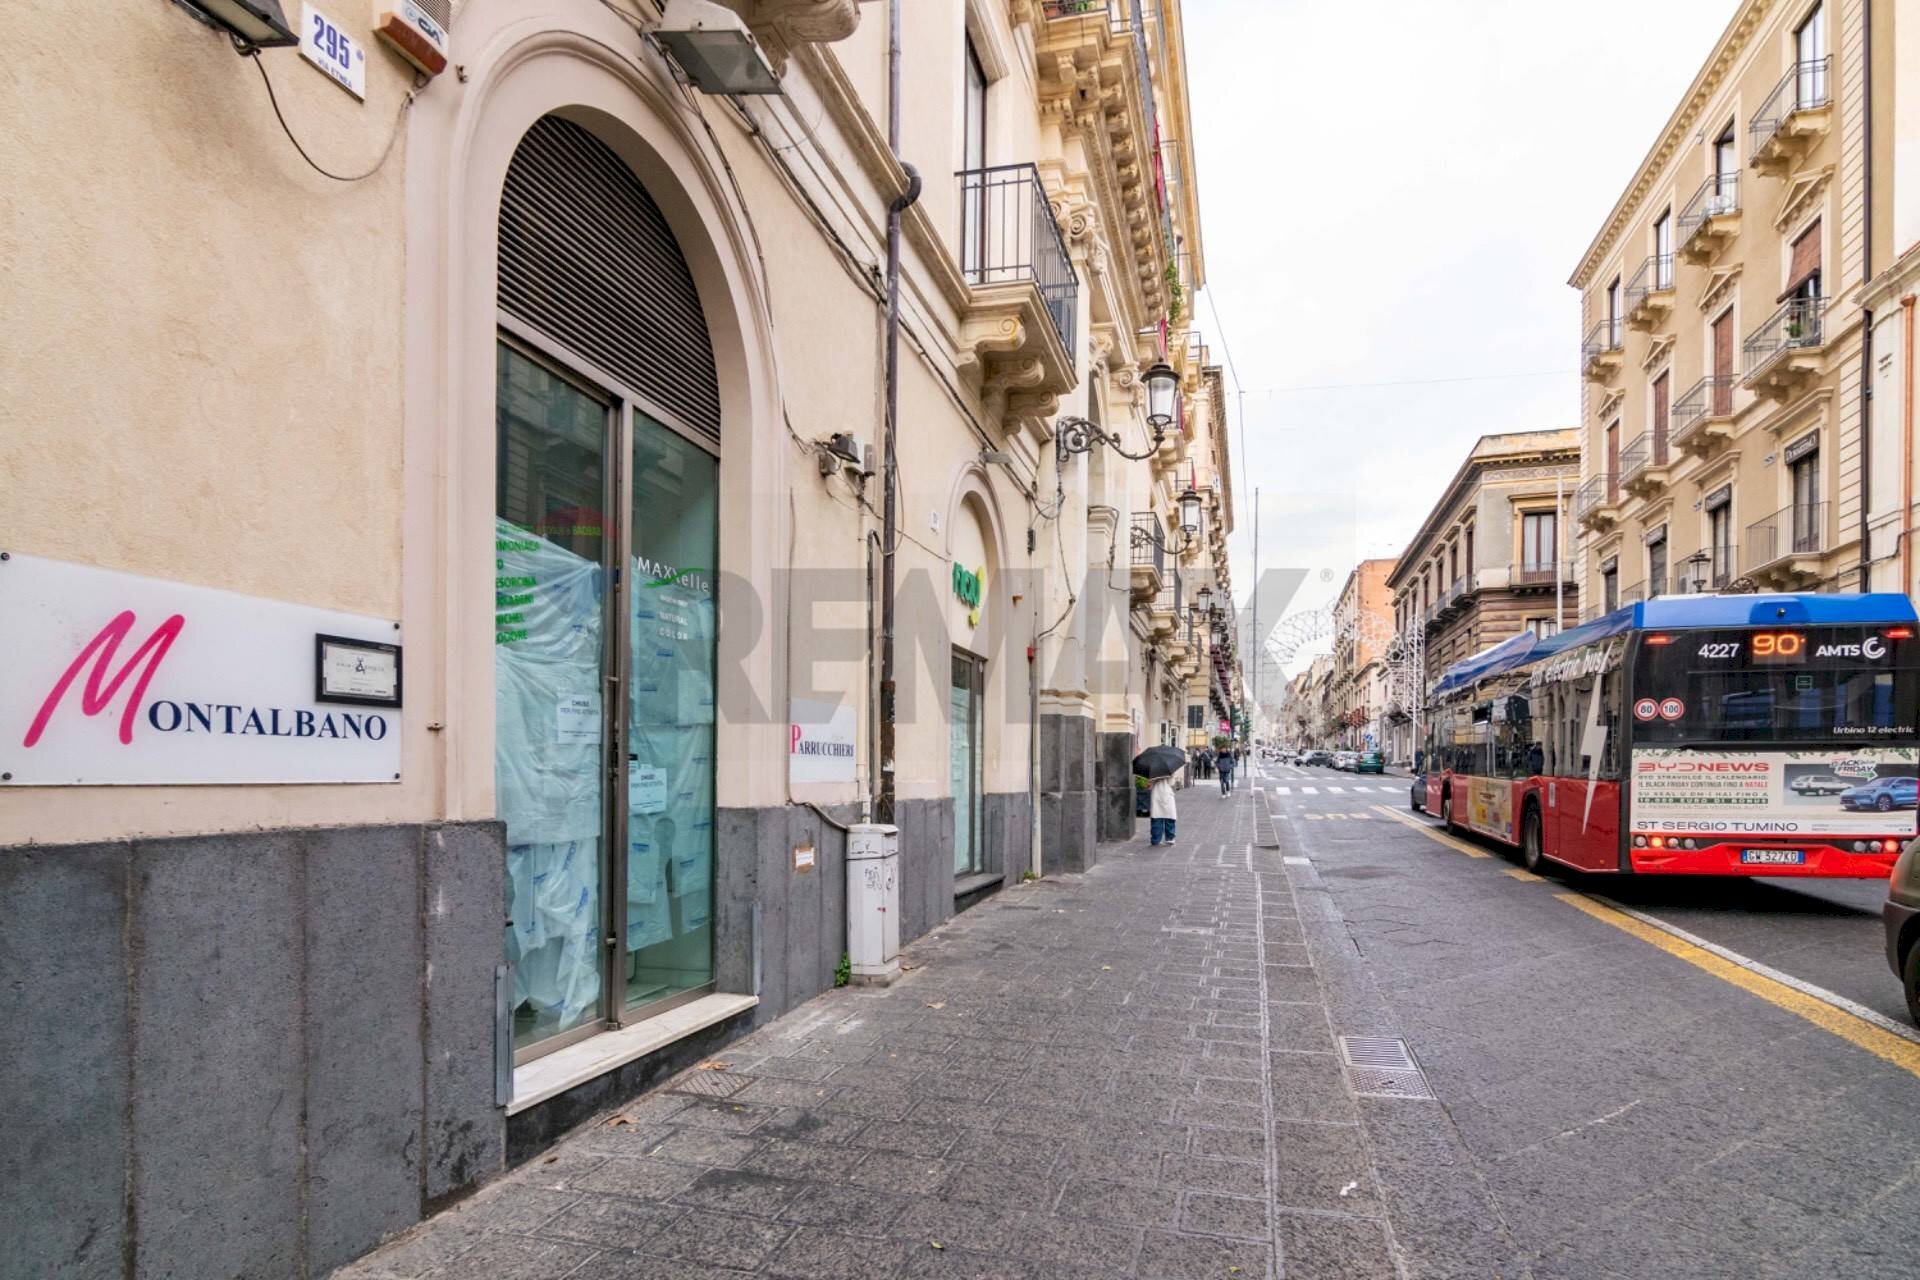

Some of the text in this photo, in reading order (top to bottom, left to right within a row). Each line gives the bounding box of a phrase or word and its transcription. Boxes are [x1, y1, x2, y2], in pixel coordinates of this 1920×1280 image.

[314, 14, 349, 69] 295
[318, 57, 352, 88] VIA ETNEA
[1698, 643, 1739, 658] 4227
[1752, 633, 1800, 655] 90
[1815, 644, 1860, 657] AMTS
[23, 610, 387, 749] MONTALBANO
[1640, 705, 1653, 714] 80
[1663, 704, 1679, 714] 100
[1833, 725, 1914, 734] Urbino 12 electric
[1637, 821, 1799, 832] ST SERGIO TUMINO
